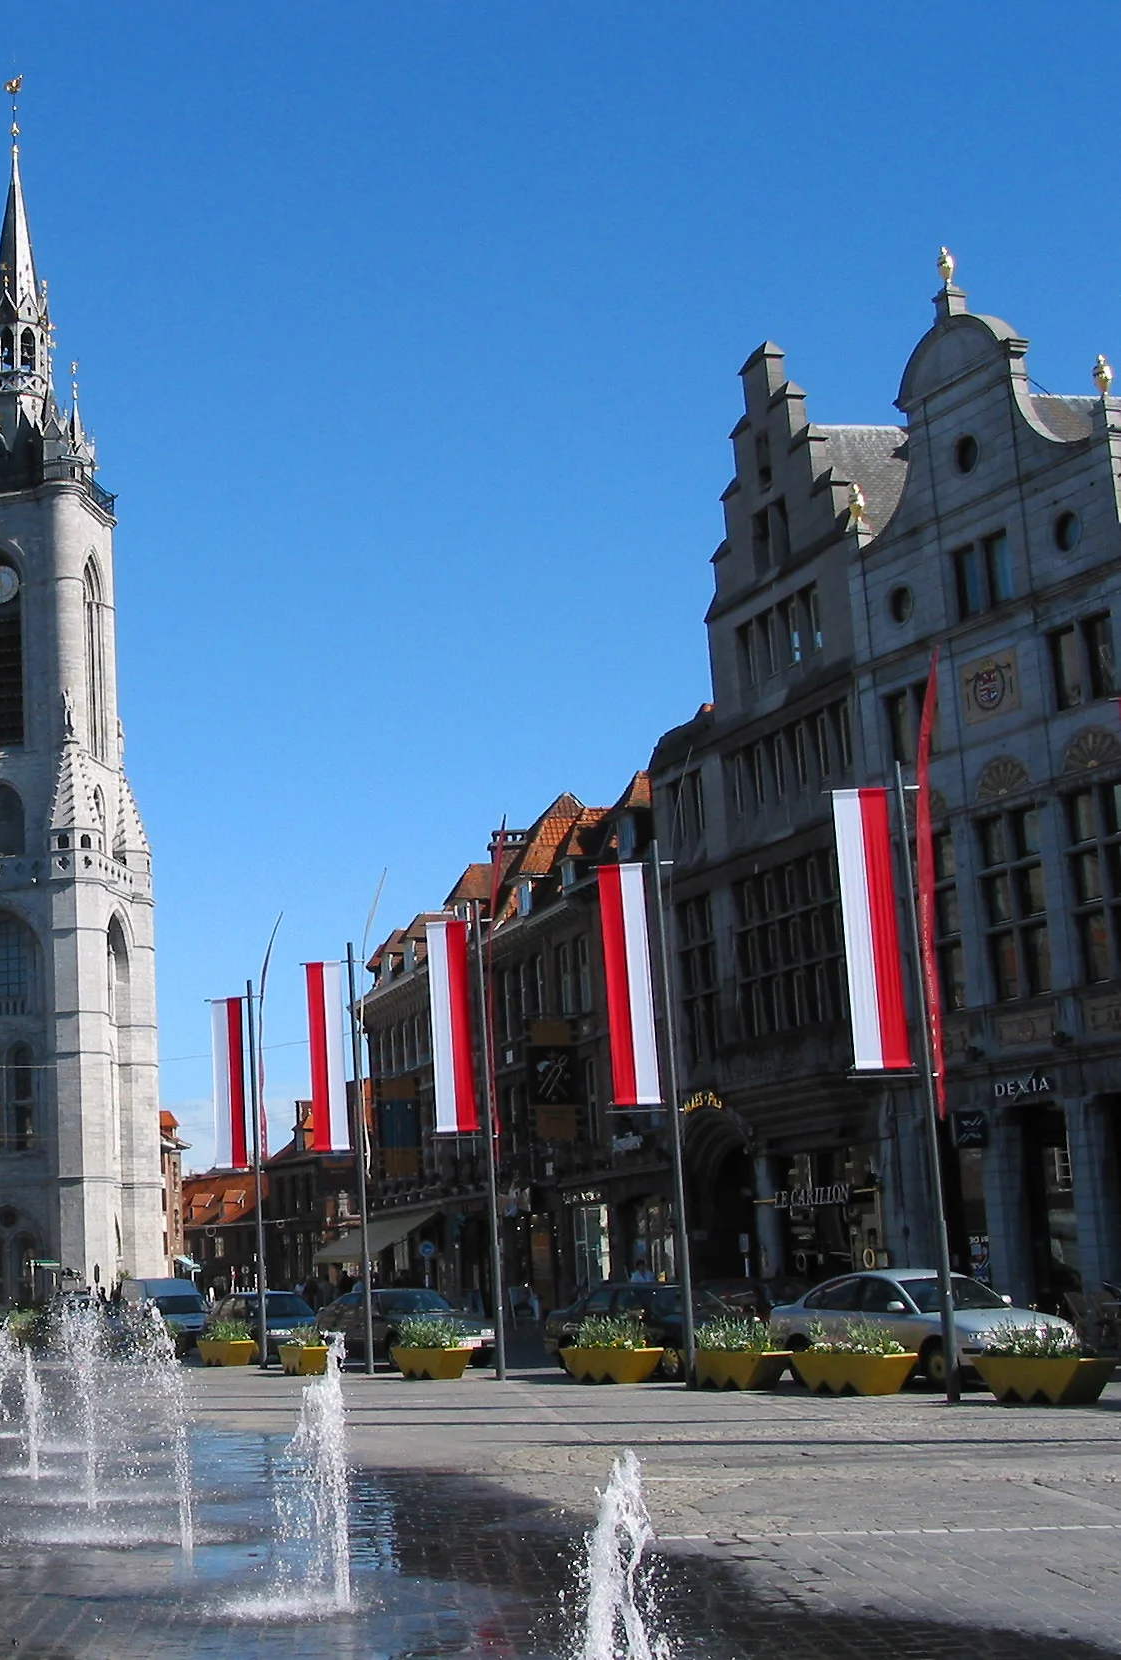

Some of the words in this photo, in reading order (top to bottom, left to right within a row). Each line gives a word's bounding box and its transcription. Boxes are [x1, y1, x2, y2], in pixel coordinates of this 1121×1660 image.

[994, 1072, 1050, 1099] DEXIA
[774, 1190, 788, 1208] LE
[790, 1183, 851, 1207] CARILLON
